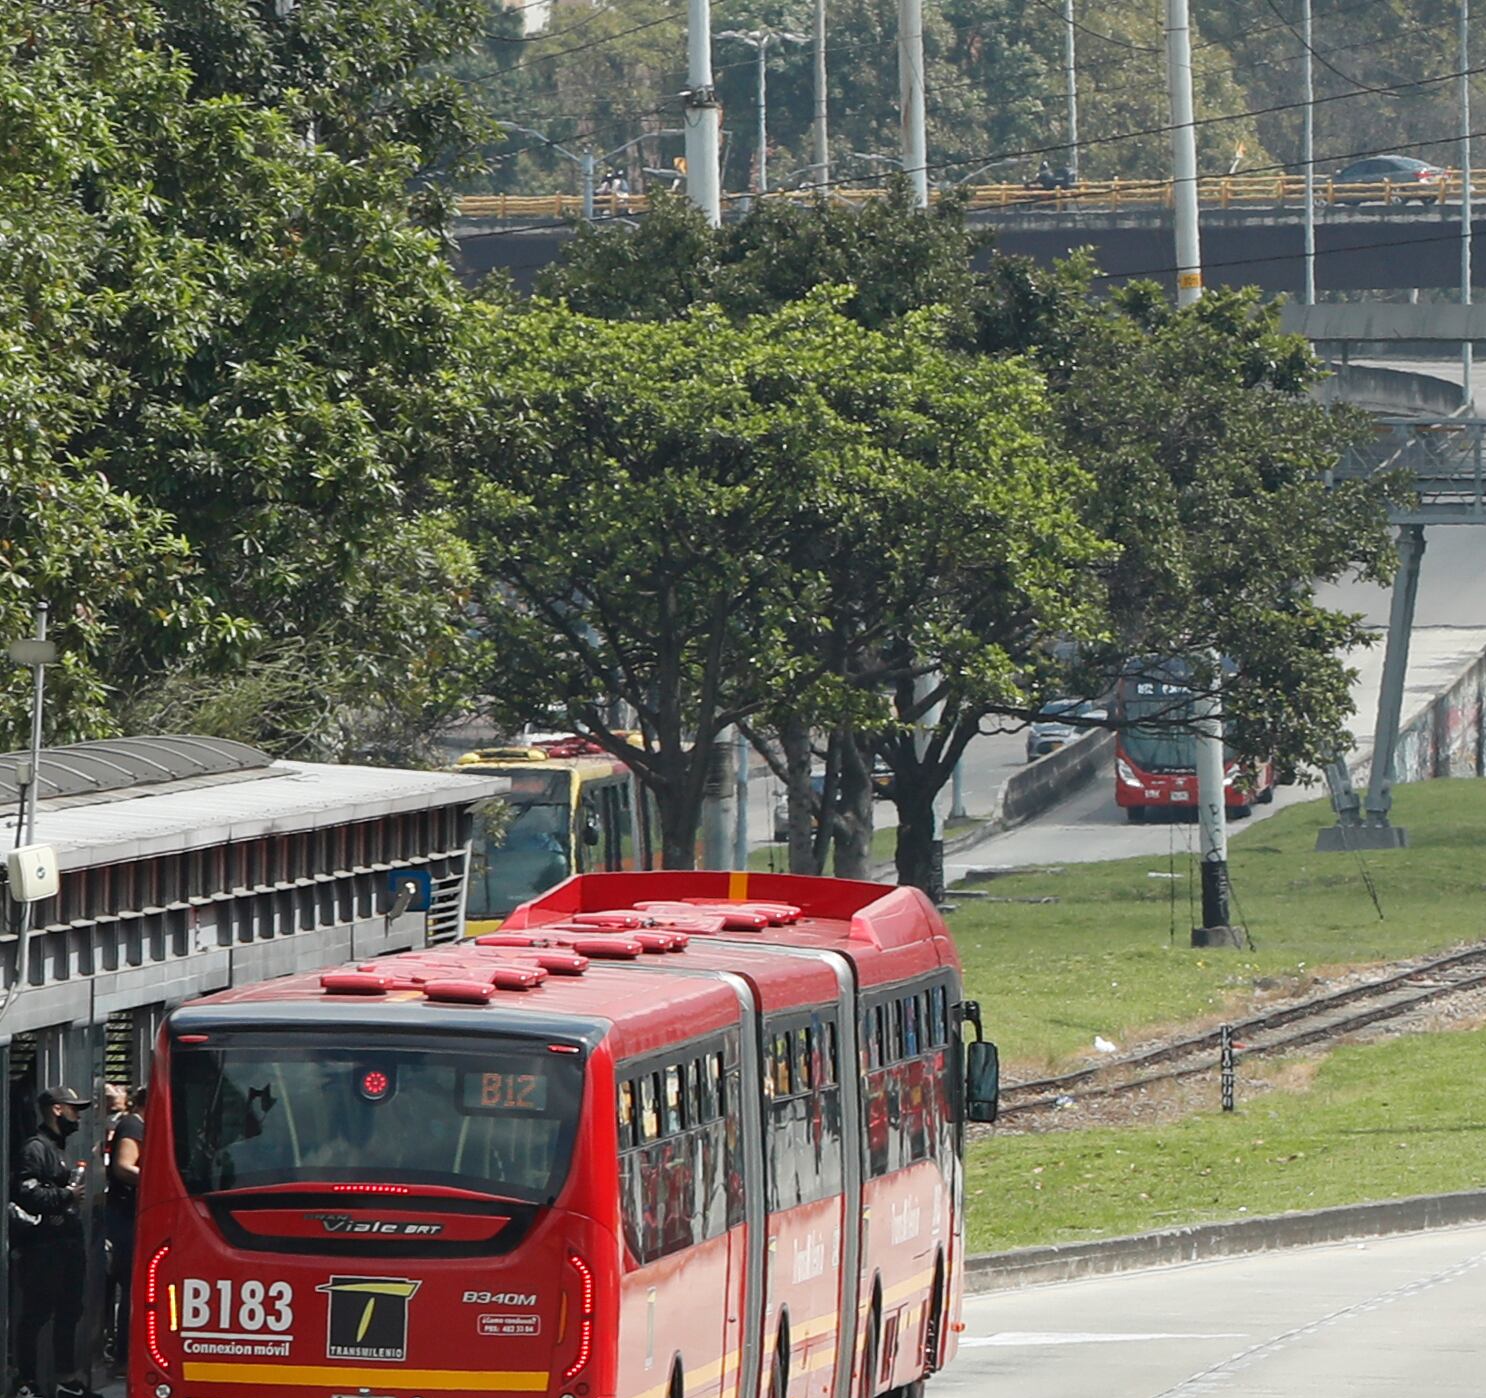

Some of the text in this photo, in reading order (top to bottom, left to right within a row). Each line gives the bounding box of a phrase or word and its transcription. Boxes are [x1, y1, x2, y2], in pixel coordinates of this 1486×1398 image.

[323, 1219, 442, 1235] Viale BRT
[183, 1279, 293, 1331] B183
[463, 1291, 537, 1305] B340M
[183, 1341, 290, 1357] Connexion móvil
[331, 1346, 403, 1358] TRANSMILENIO
